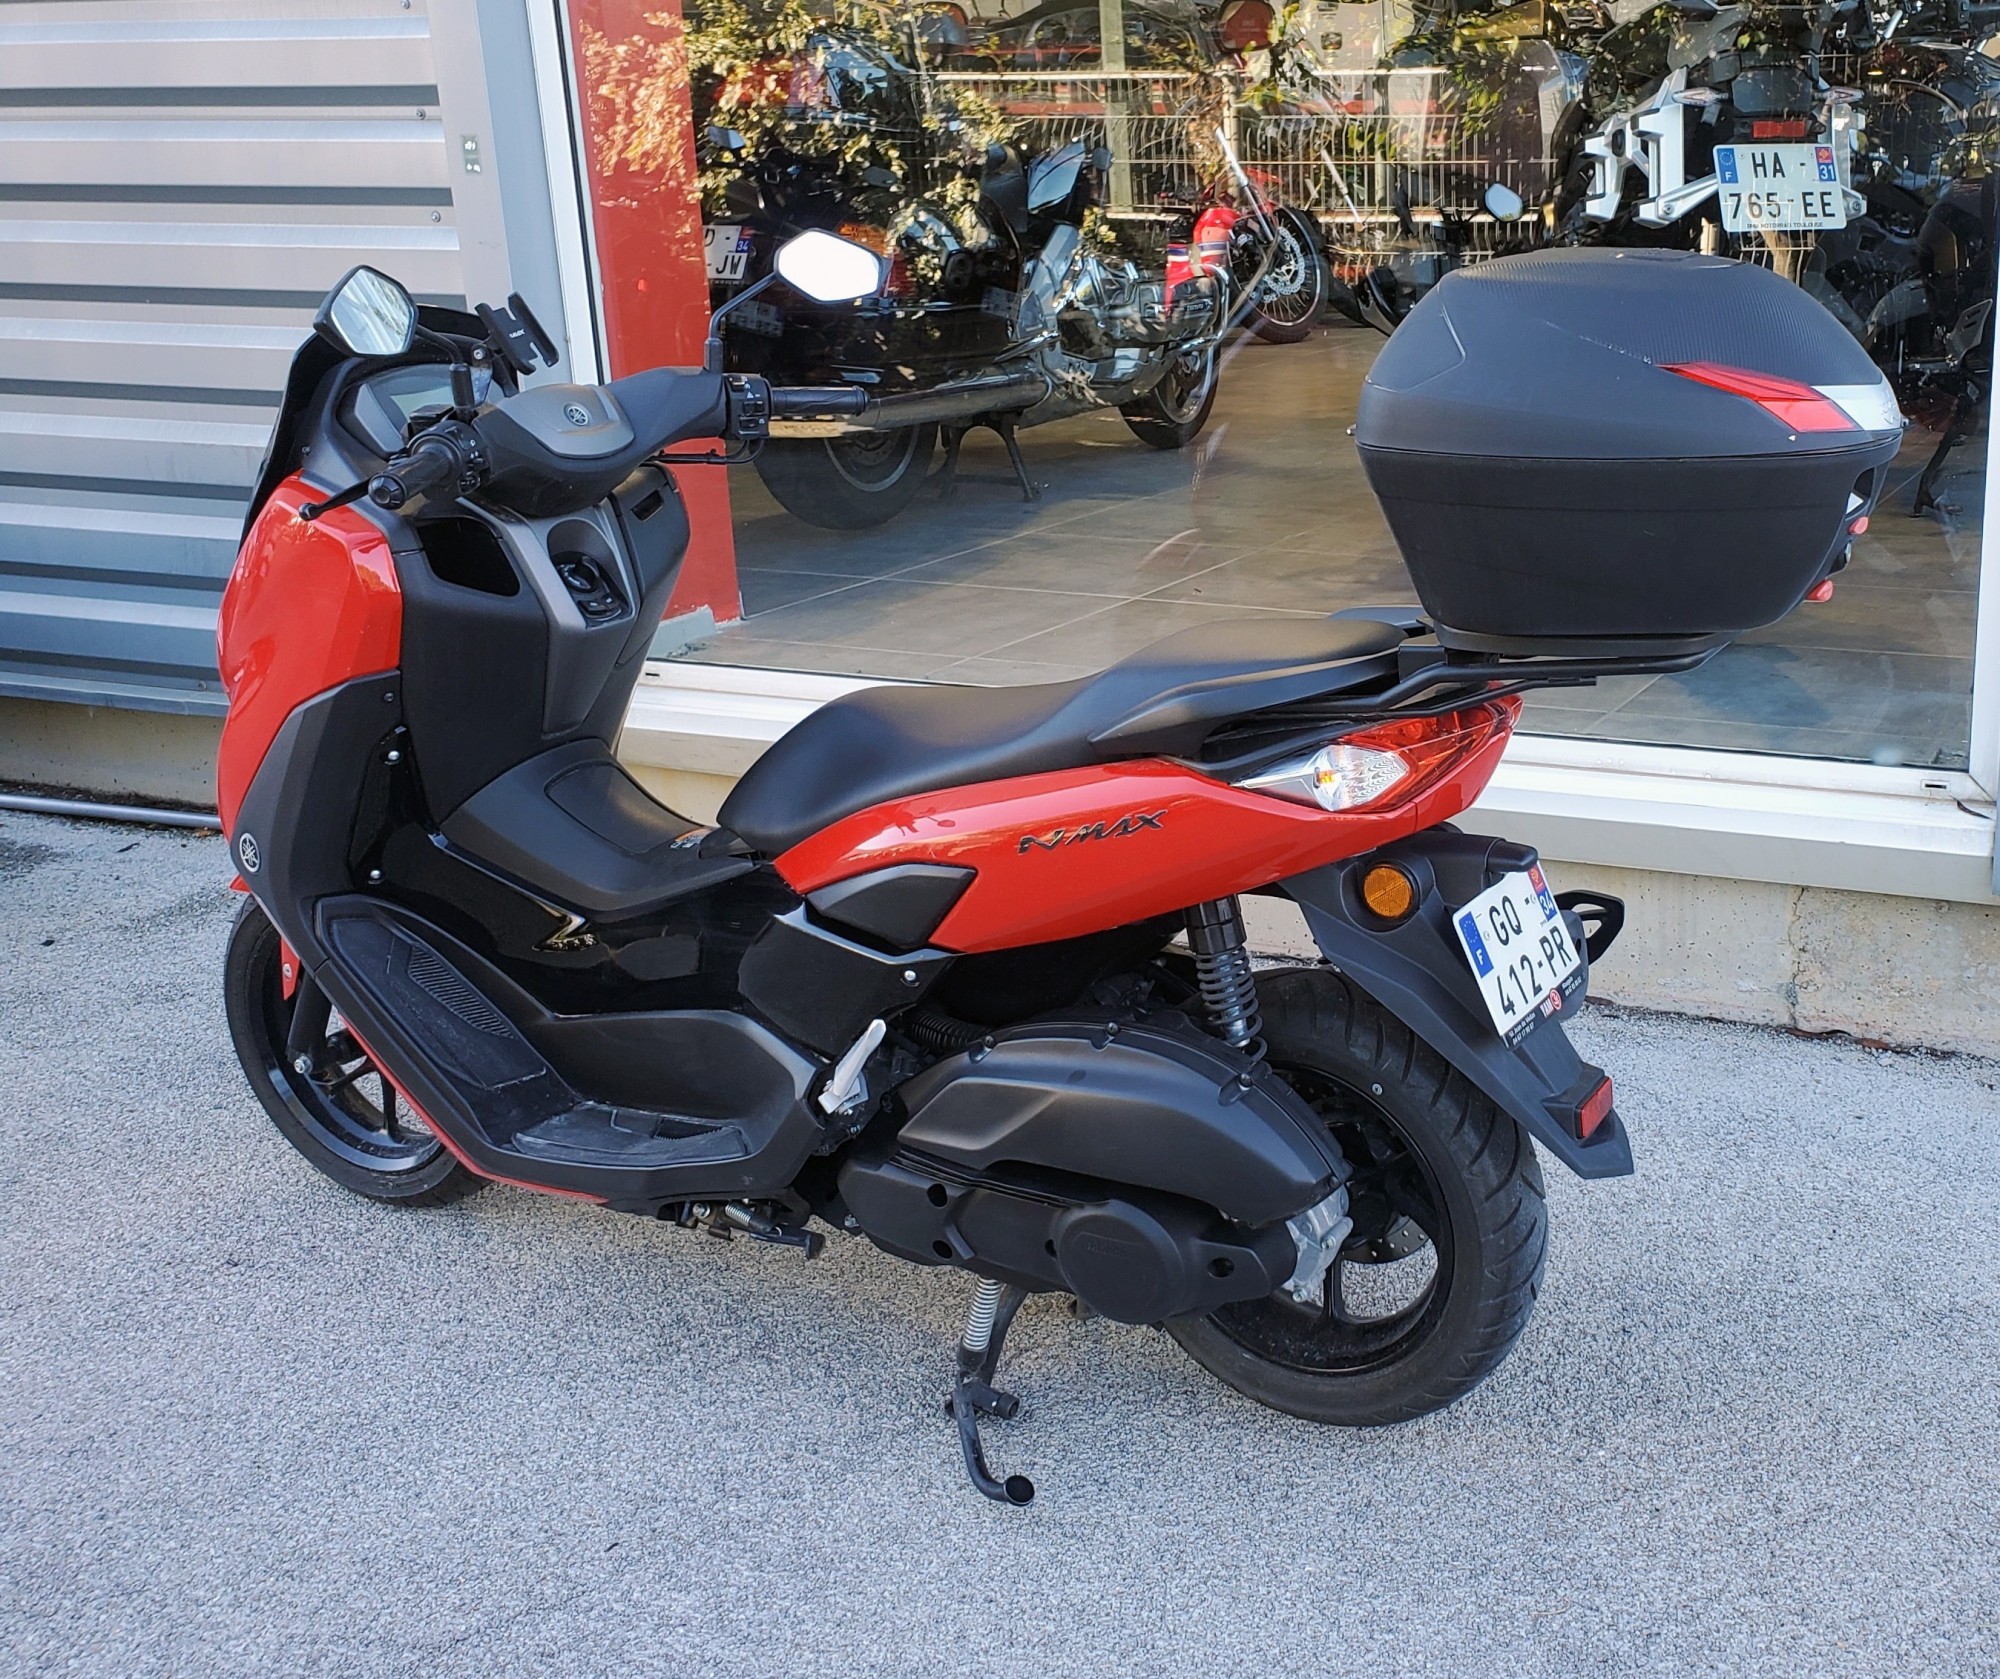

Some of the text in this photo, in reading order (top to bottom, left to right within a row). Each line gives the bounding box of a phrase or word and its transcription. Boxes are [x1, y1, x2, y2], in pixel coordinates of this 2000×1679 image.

[1725, 171, 1733, 181] F
[1819, 164, 1836, 180] 31
[737, 240, 749, 251] 34
[1017, 809, 1168, 855] NMAX
[1540, 890, 1555, 915] 34
[1475, 948, 1484, 966] F
